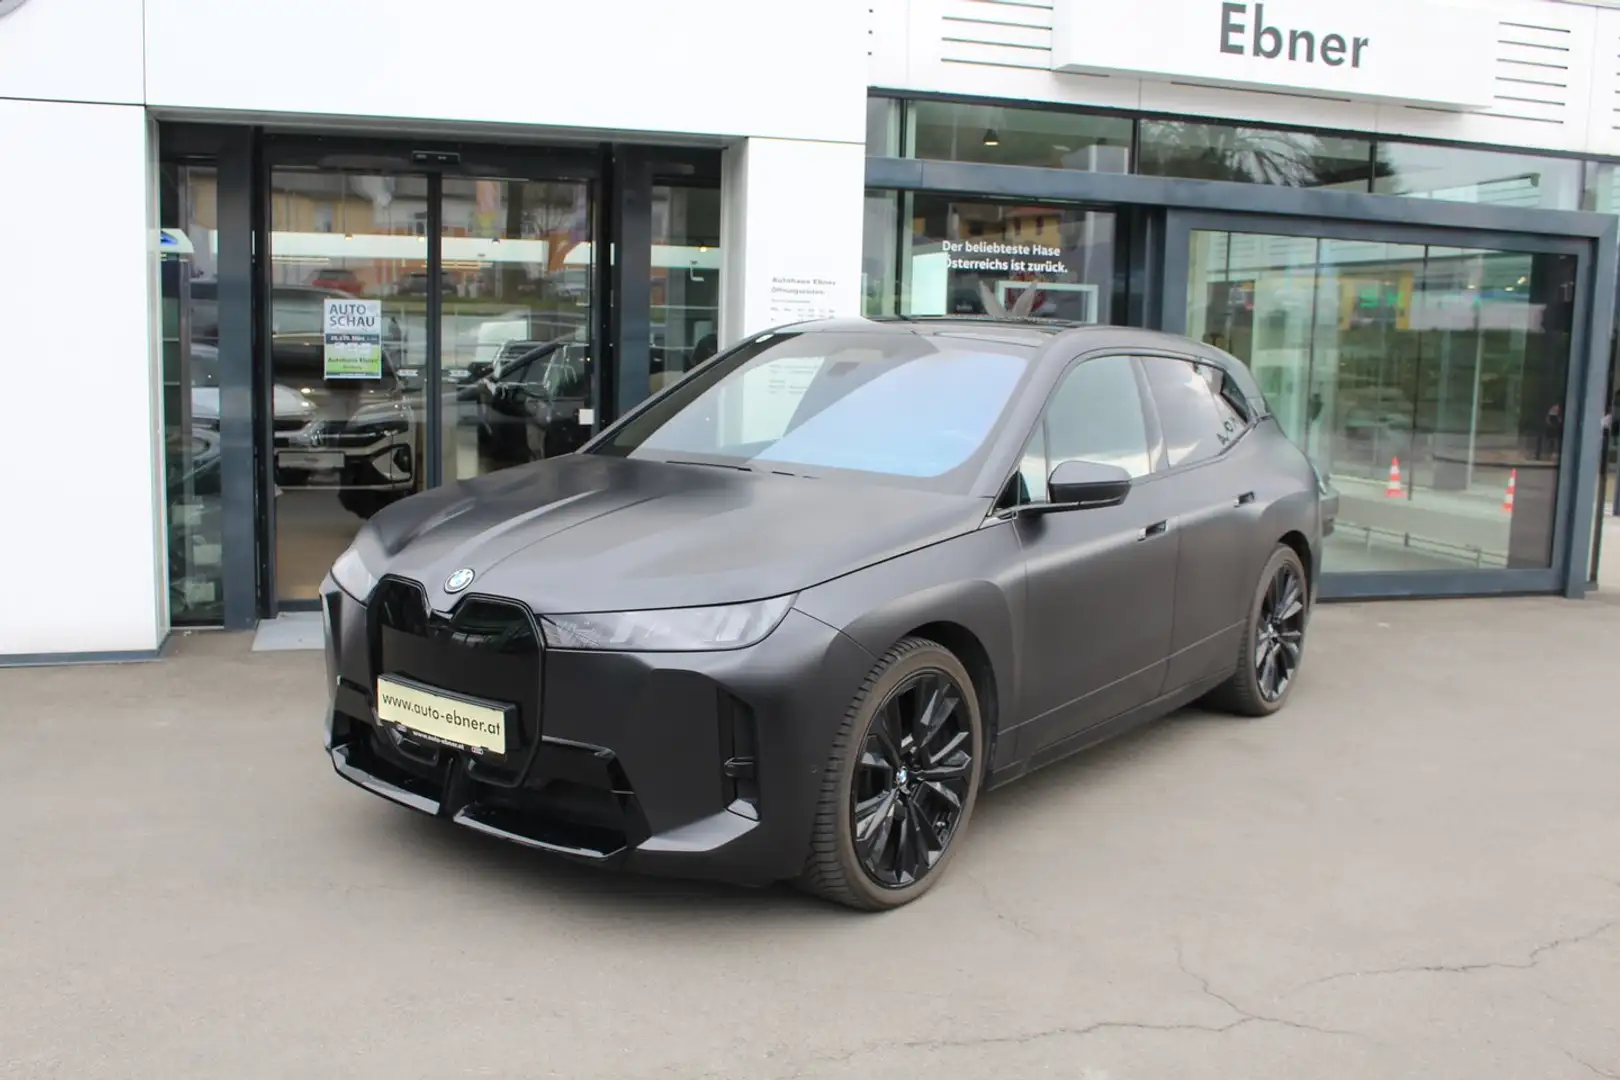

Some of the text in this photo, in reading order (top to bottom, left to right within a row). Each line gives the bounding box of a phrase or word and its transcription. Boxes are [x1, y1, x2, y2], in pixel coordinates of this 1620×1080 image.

[1220, 2, 1369, 68] Ebner
[942, 240, 1061, 257] Der beliebteste Hase
[1011, 259, 1025, 272] ist
[1028, 260, 1068, 273] zurück.
[329, 303, 367, 316] AUTO
[329, 315, 376, 327] SCHAU
[382, 693, 501, 736] www.auto-ebner.at
